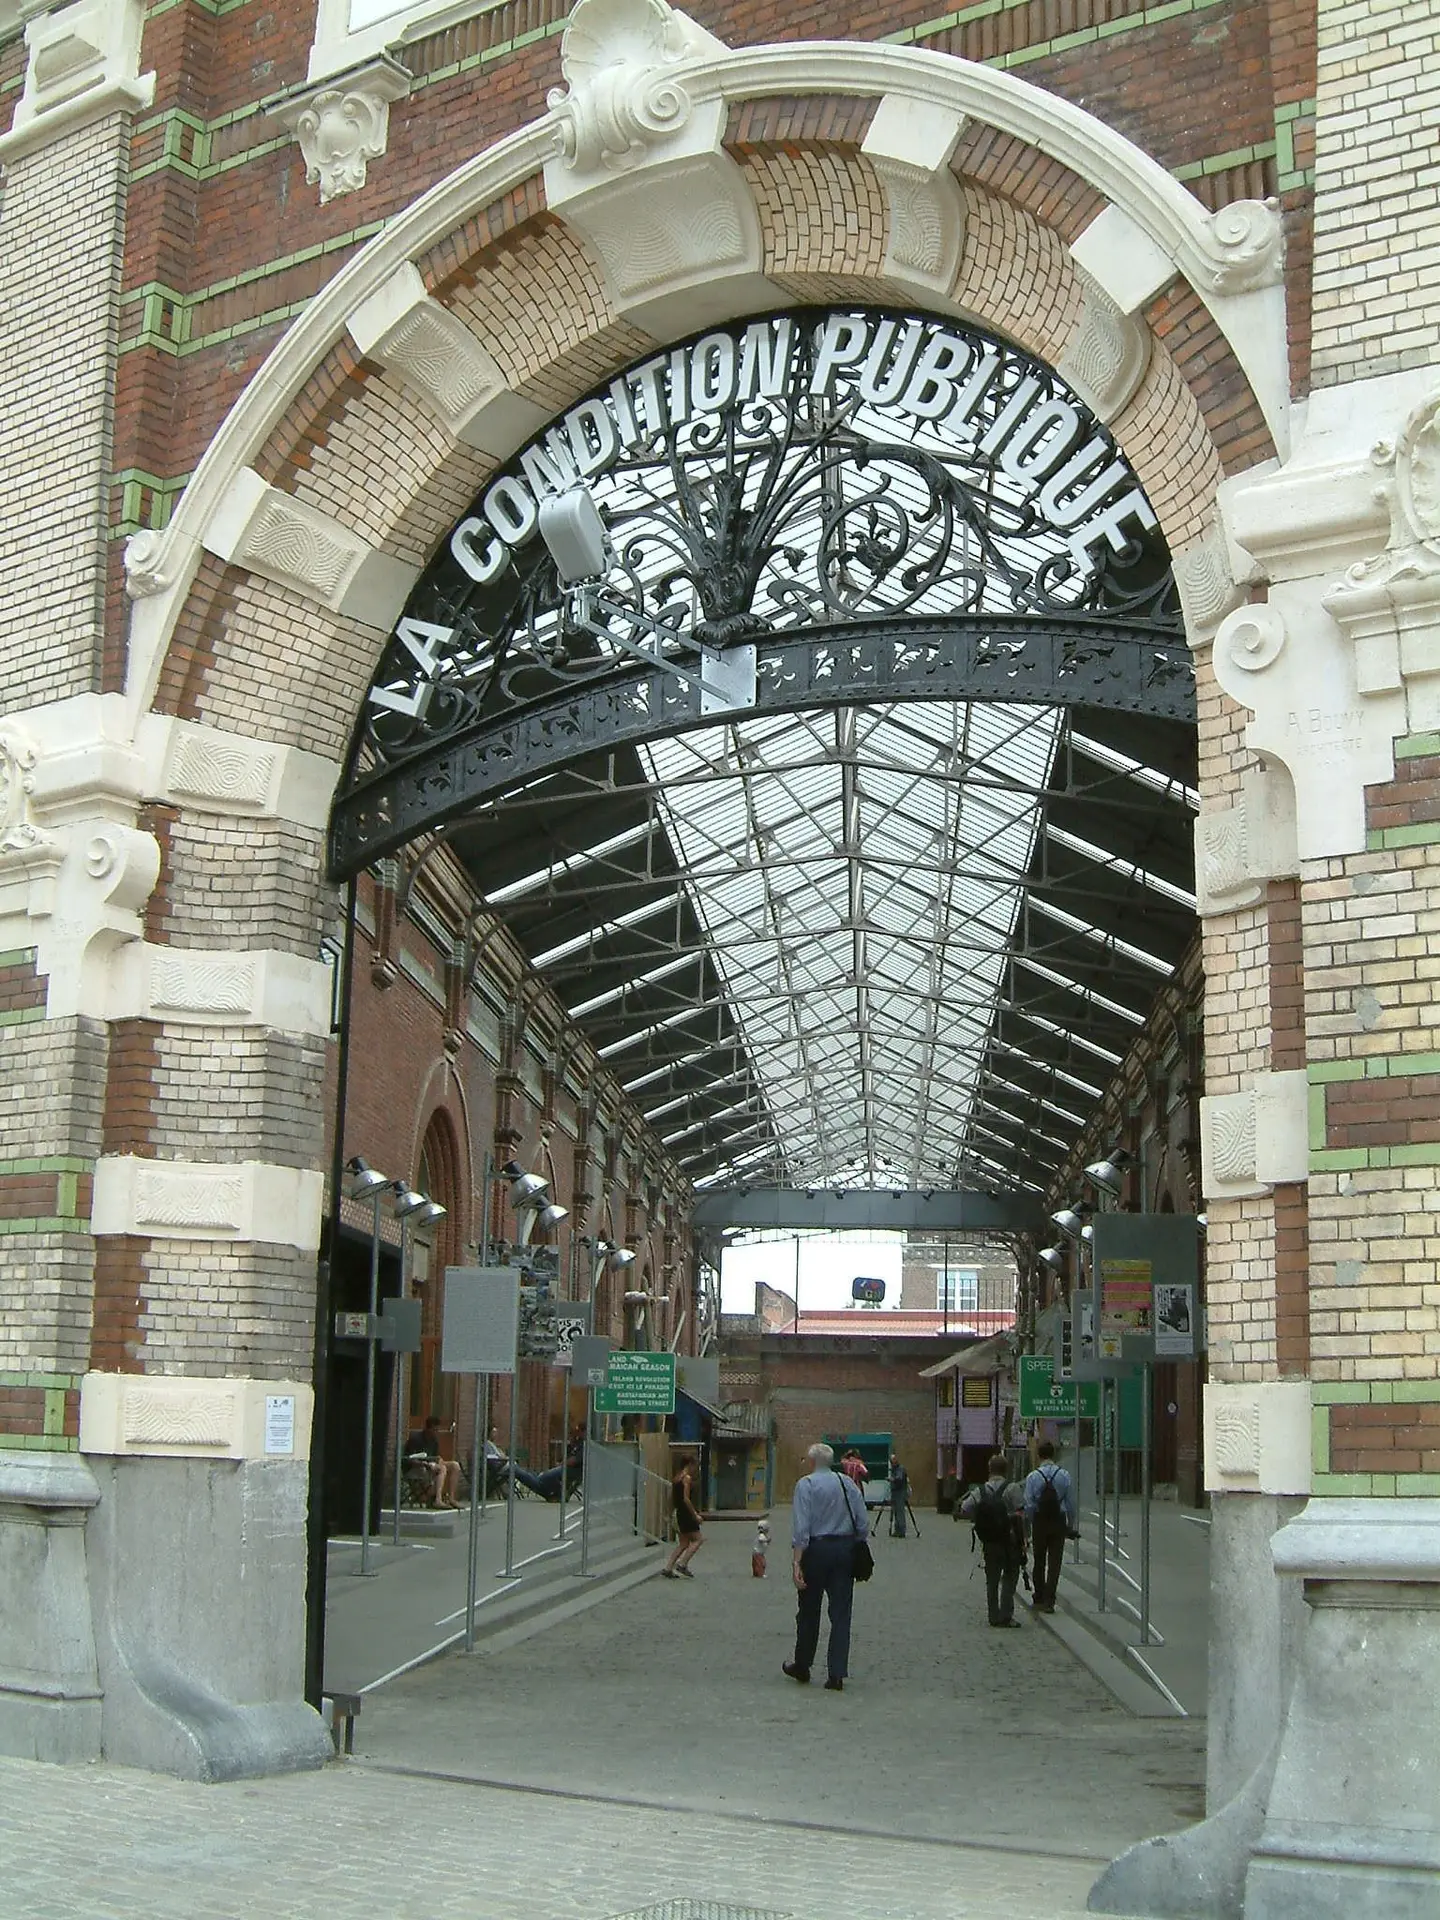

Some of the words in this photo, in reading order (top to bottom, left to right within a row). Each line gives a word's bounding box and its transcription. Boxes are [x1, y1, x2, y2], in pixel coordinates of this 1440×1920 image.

[369, 614, 455, 719] LA
[450, 317, 792, 587] CONDITION
[811, 313, 1158, 578] PUBLIQUE
